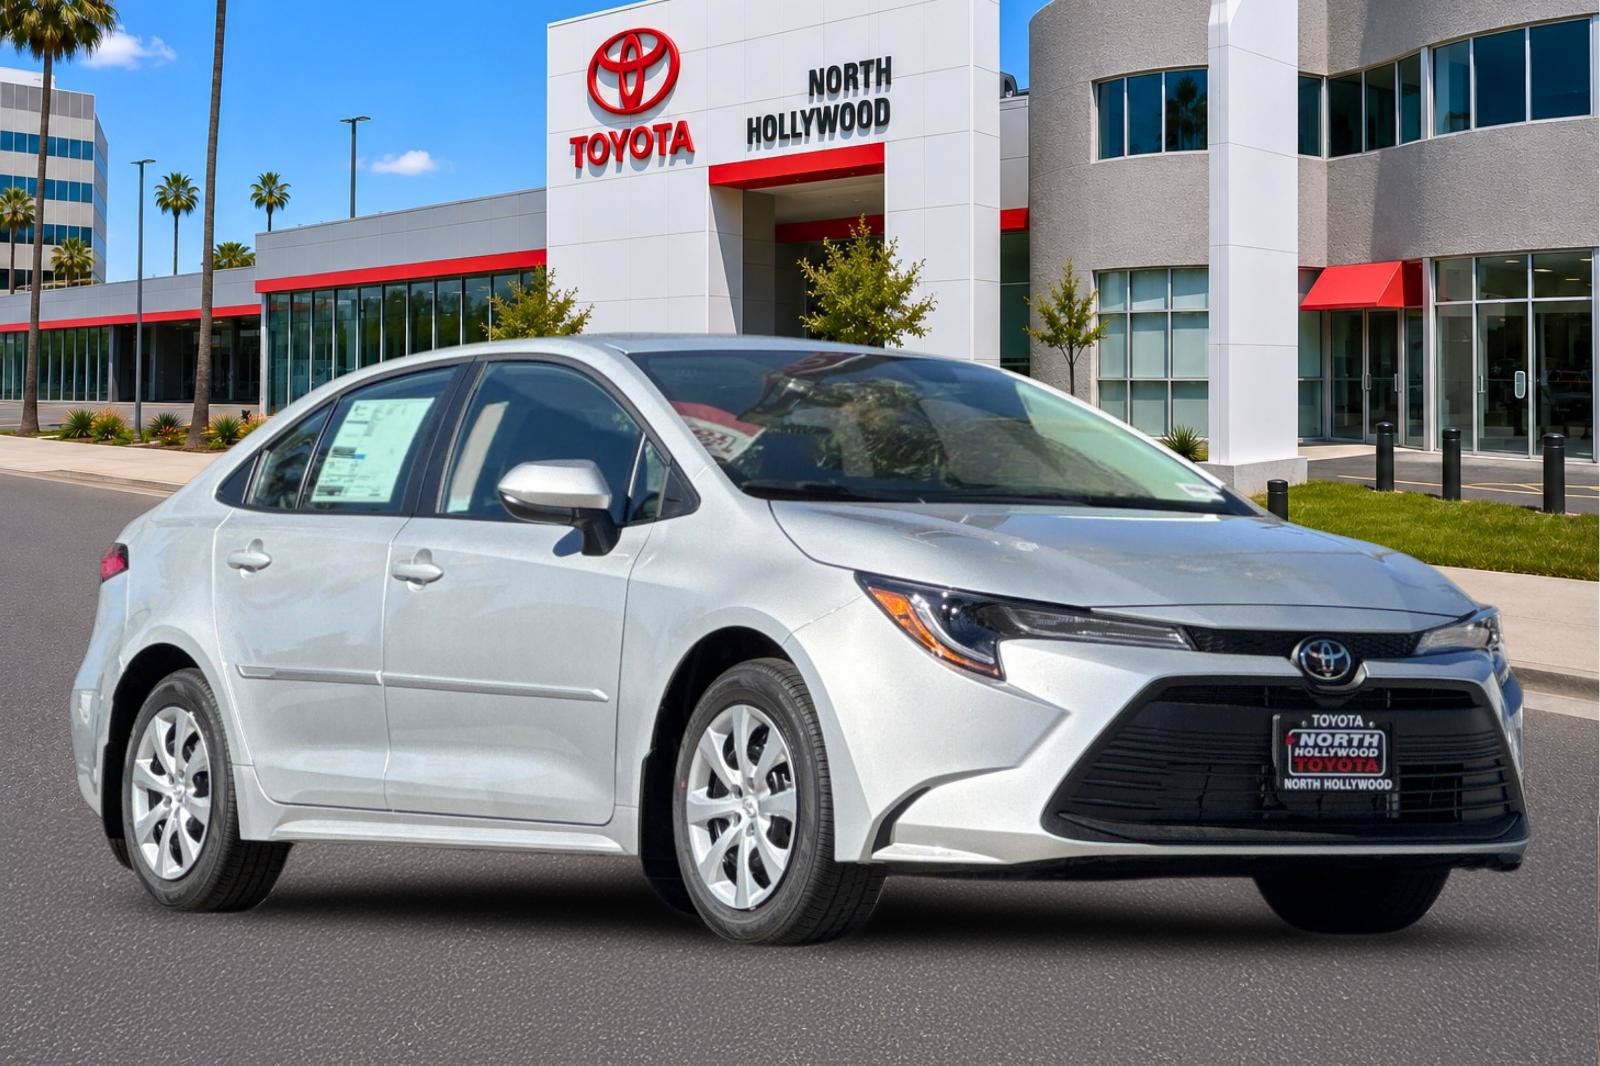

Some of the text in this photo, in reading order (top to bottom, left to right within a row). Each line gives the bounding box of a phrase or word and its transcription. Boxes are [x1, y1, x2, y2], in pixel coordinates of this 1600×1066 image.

[808, 55, 892, 97] NORTH
[746, 97, 891, 145] HOLLYWOOD
[569, 120, 695, 168] TOYOTA
[1312, 714, 1364, 727] TOYOTA
[1299, 733, 1380, 747] NORTH
[1294, 747, 1379, 757] HOLLYWOOD
[1294, 758, 1379, 772] TOYOTA
[1284, 778, 1393, 790] NORTH HOLLYWOOD
